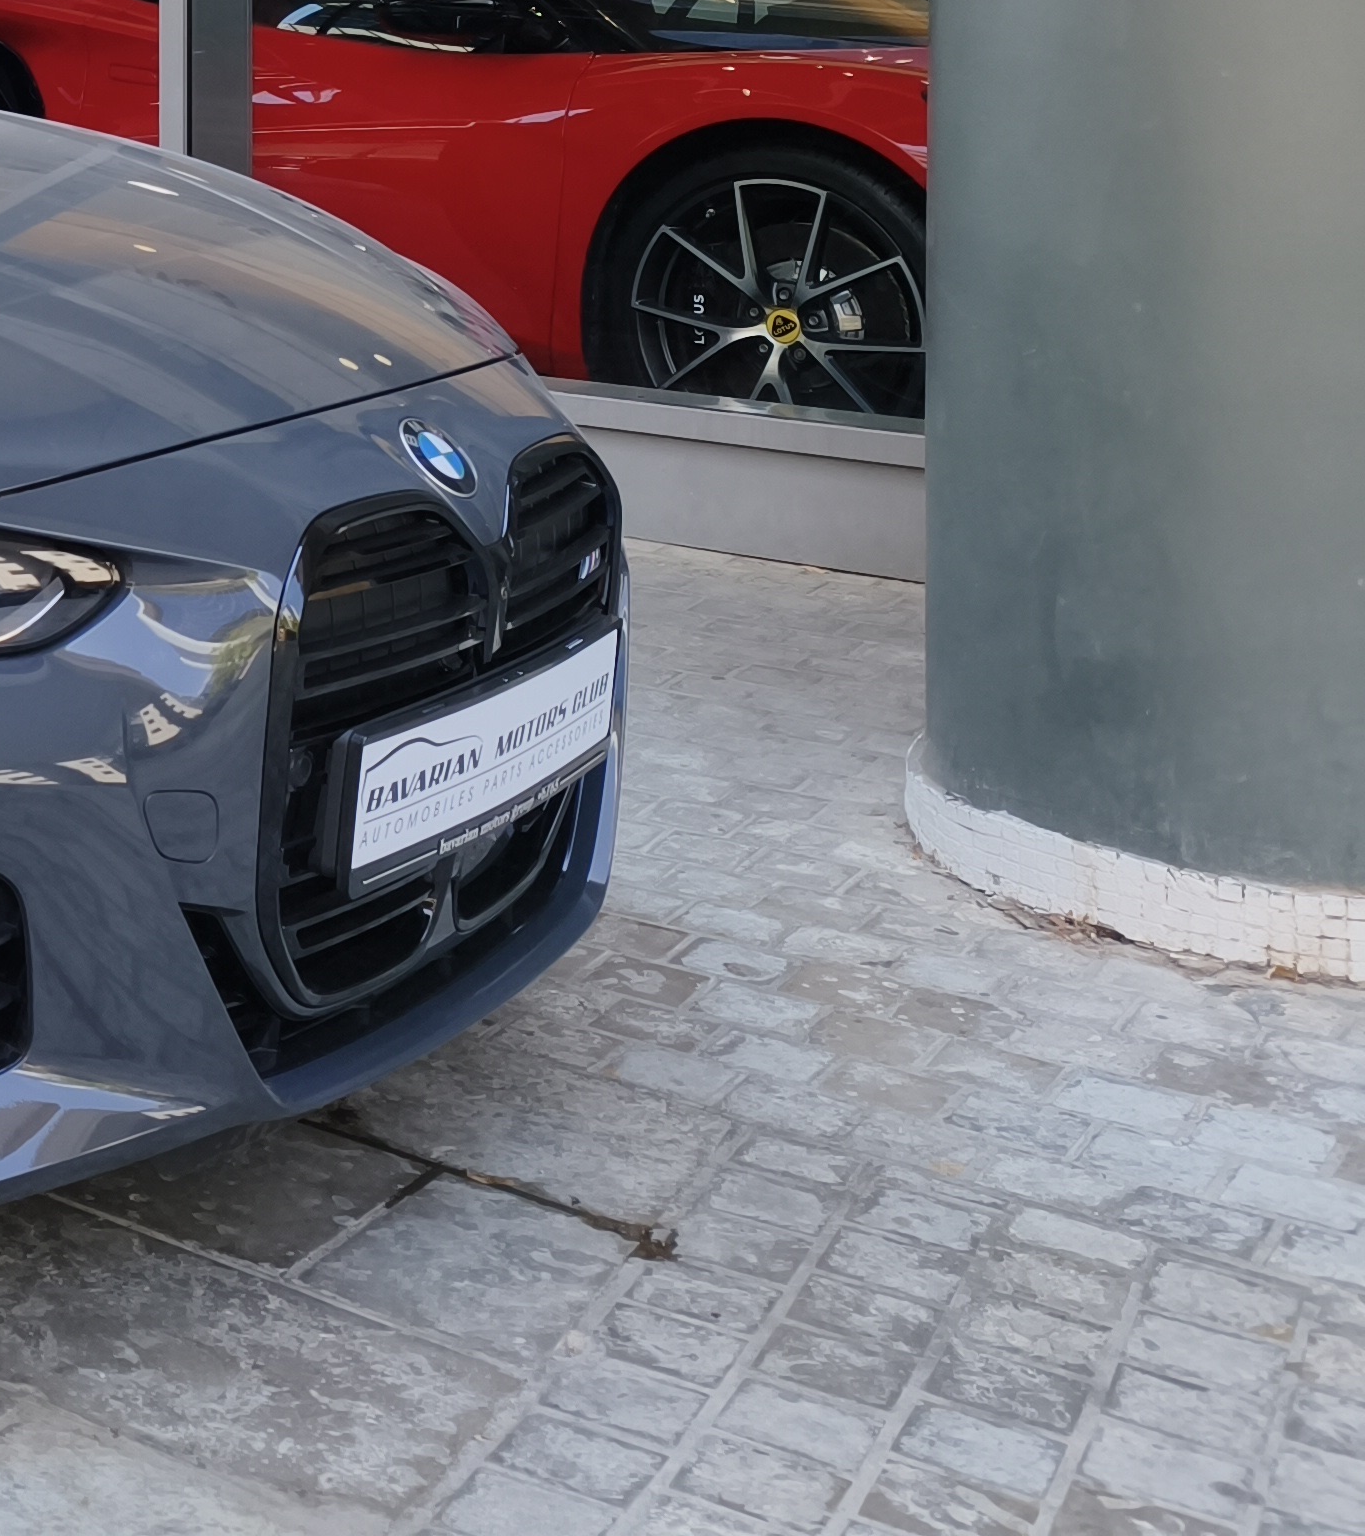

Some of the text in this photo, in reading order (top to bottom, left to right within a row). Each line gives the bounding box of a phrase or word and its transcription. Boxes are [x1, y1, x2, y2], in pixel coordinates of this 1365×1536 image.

[773, 321, 796, 337] LOTUS
[359, 785, 474, 848] AUTOMOBILES
[483, 761, 523, 796] PARTS
[528, 709, 605, 769] ACCESSORIES
[366, 744, 483, 814] BAVARIAN
[495, 698, 569, 760] MOTORS
[571, 672, 610, 716] CLUB
